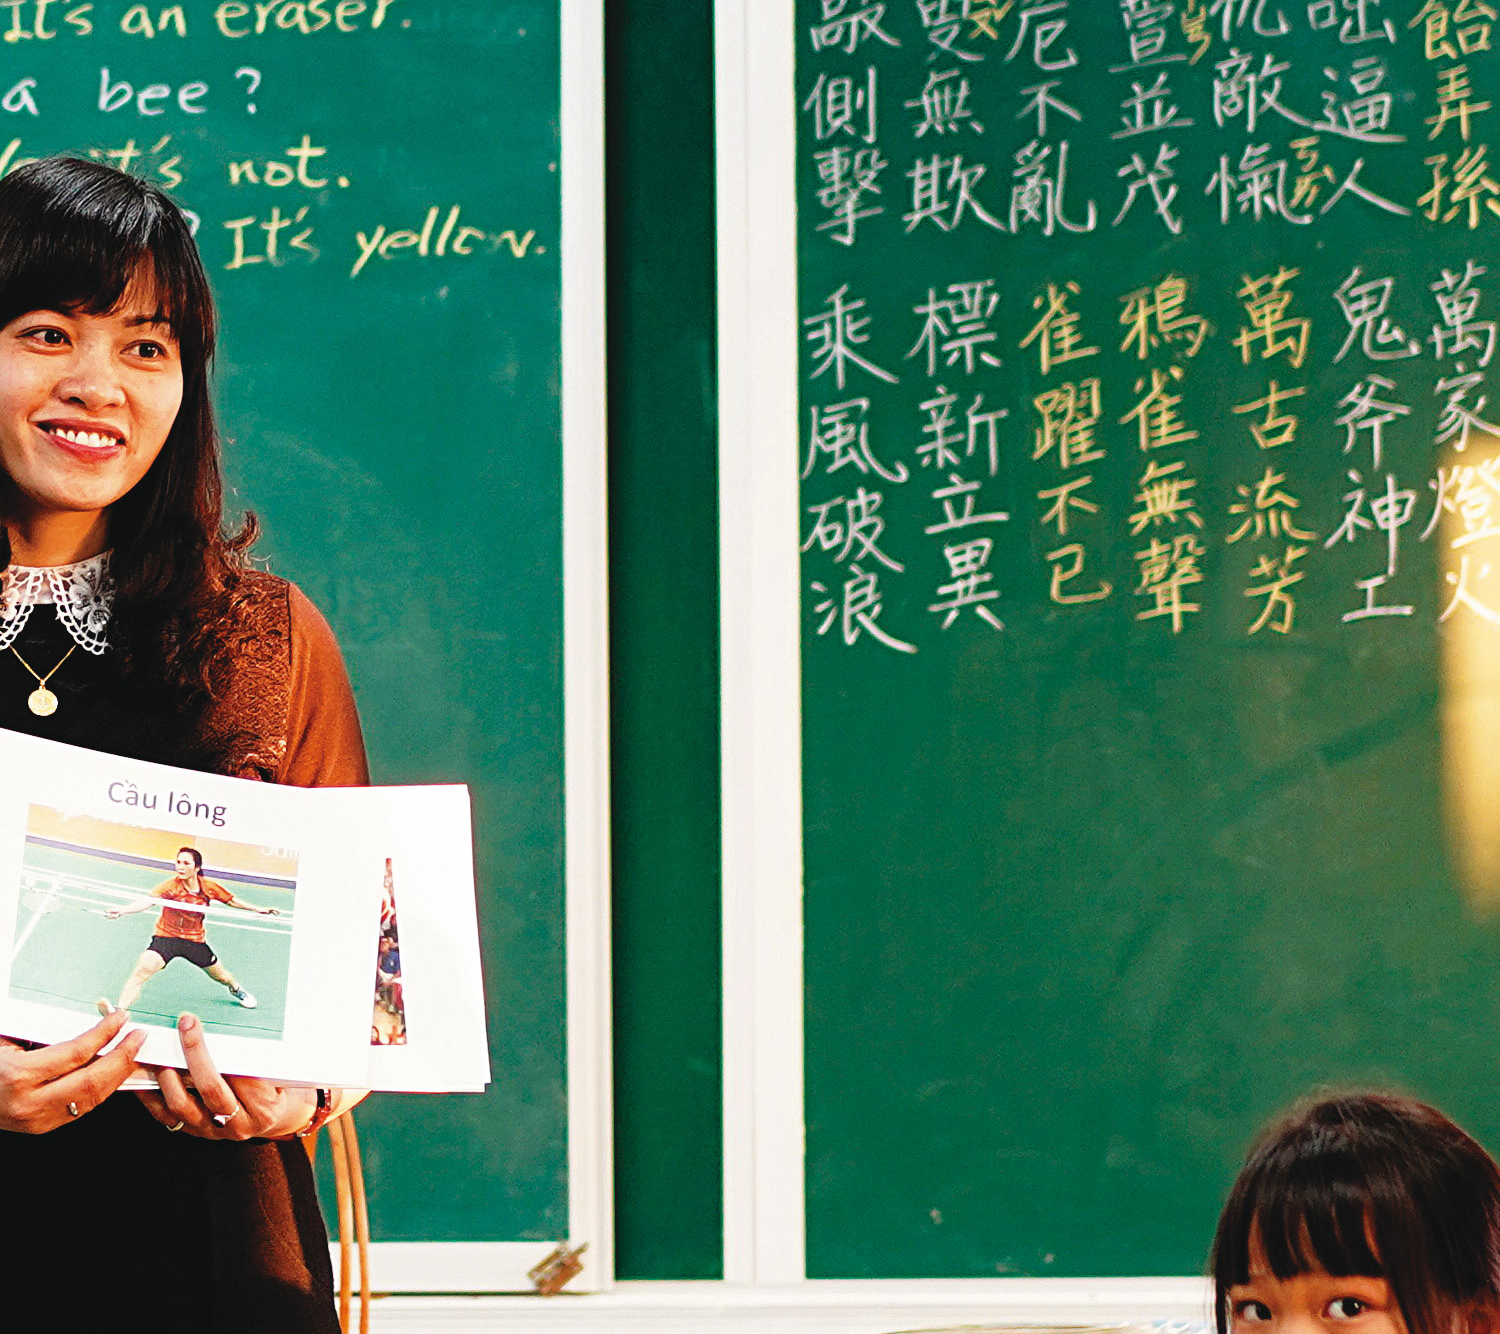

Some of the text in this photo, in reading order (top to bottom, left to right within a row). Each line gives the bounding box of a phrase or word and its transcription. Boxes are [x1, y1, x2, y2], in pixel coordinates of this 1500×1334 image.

[120, 5, 187, 39] an
[0, 75, 40, 116] a
[227, 134, 352, 189] not.
[106, 778, 229, 828] Cầu lông
